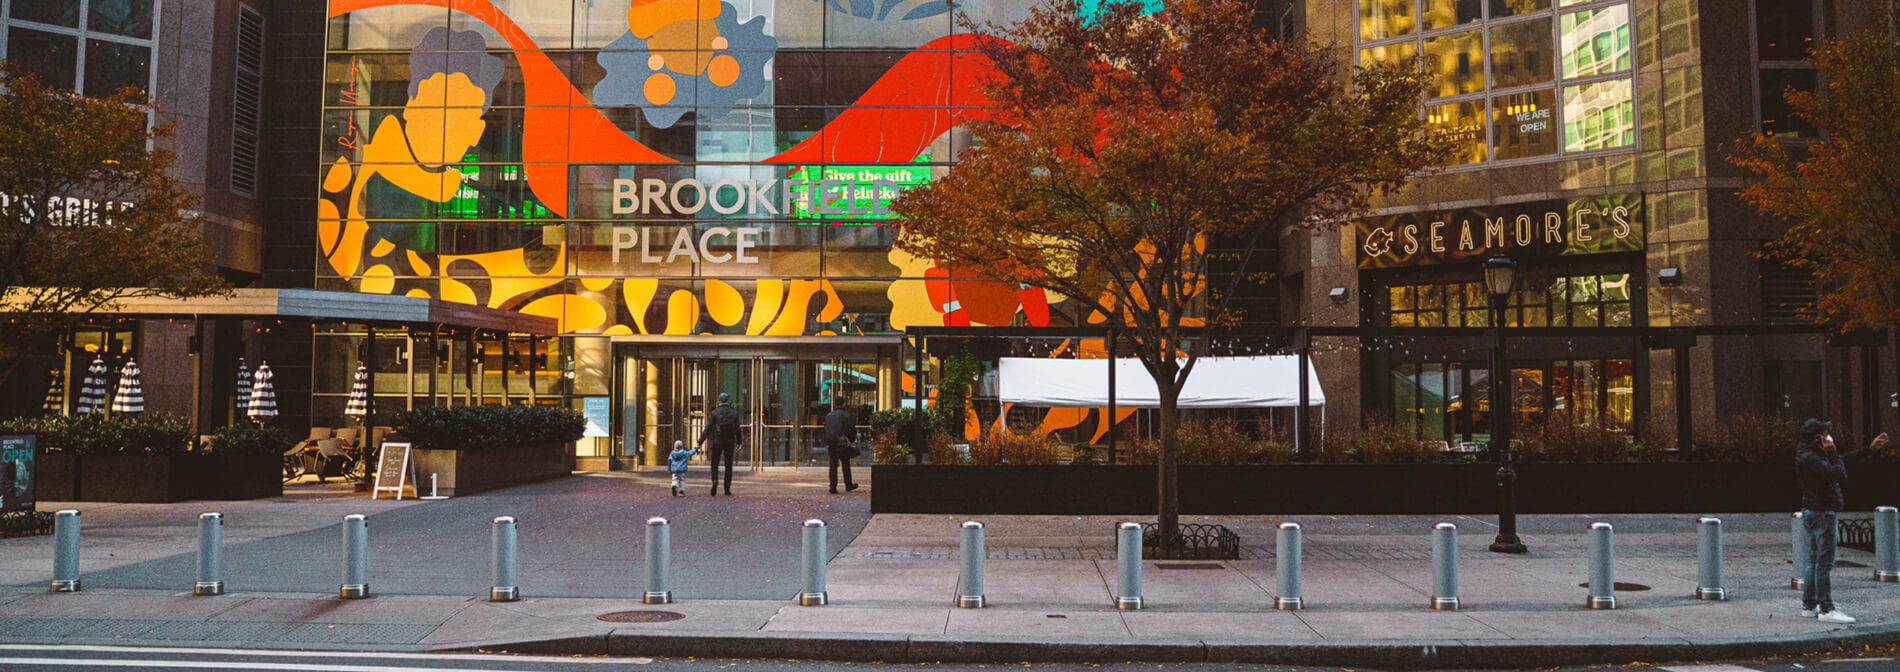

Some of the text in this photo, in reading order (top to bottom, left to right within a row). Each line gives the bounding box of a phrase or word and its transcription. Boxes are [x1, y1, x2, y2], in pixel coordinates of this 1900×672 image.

[1516, 108, 1551, 121] WE ARE
[1520, 121, 1547, 133] OPEN
[858, 170, 881, 182] the
[886, 169, 912, 183] gift
[612, 178, 901, 215] BROOKFIELD
[842, 187, 899, 200] Heinke
[1404, 206, 1631, 254] SEAMORE'S
[612, 227, 759, 263] PLACE
[2, 449, 33, 463] OPEN
